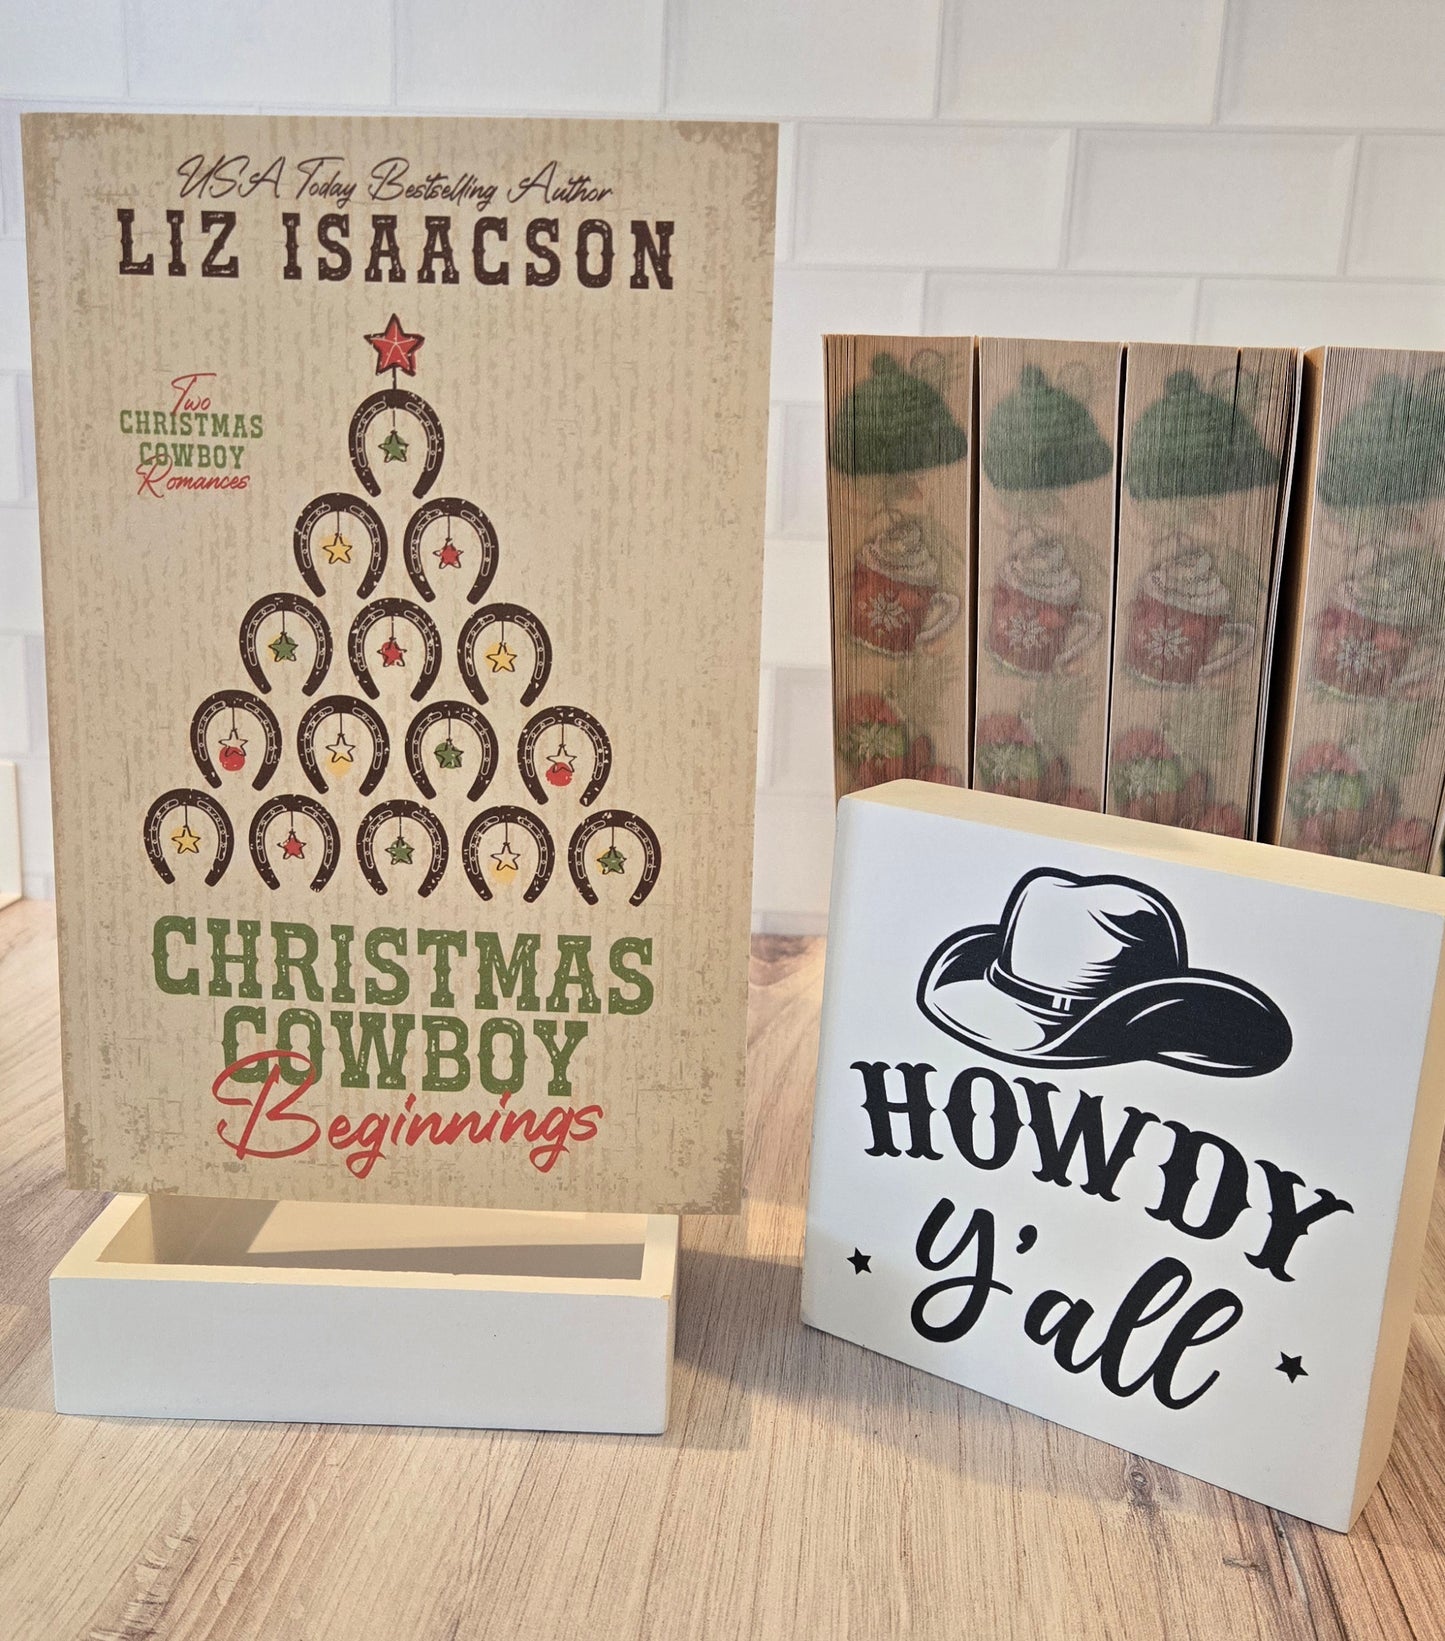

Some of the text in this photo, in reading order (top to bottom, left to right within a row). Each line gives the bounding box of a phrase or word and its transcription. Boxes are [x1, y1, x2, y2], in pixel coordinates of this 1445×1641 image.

[177, 155, 613, 209] USA Today Bestselling Author
[117, 208, 675, 290] LIZ ISAACSON
[120, 410, 263, 438] CHRISTMAS
[171, 373, 217, 415] Two
[136, 454, 250, 498] Romances
[139, 442, 245, 469] COWBOY
[152, 915, 655, 1015] CHRISTMAS
[221, 1006, 589, 1097] COWBOY
[212, 1050, 604, 1179] Beginnings
[850, 1060, 1355, 1282] HOWDY
